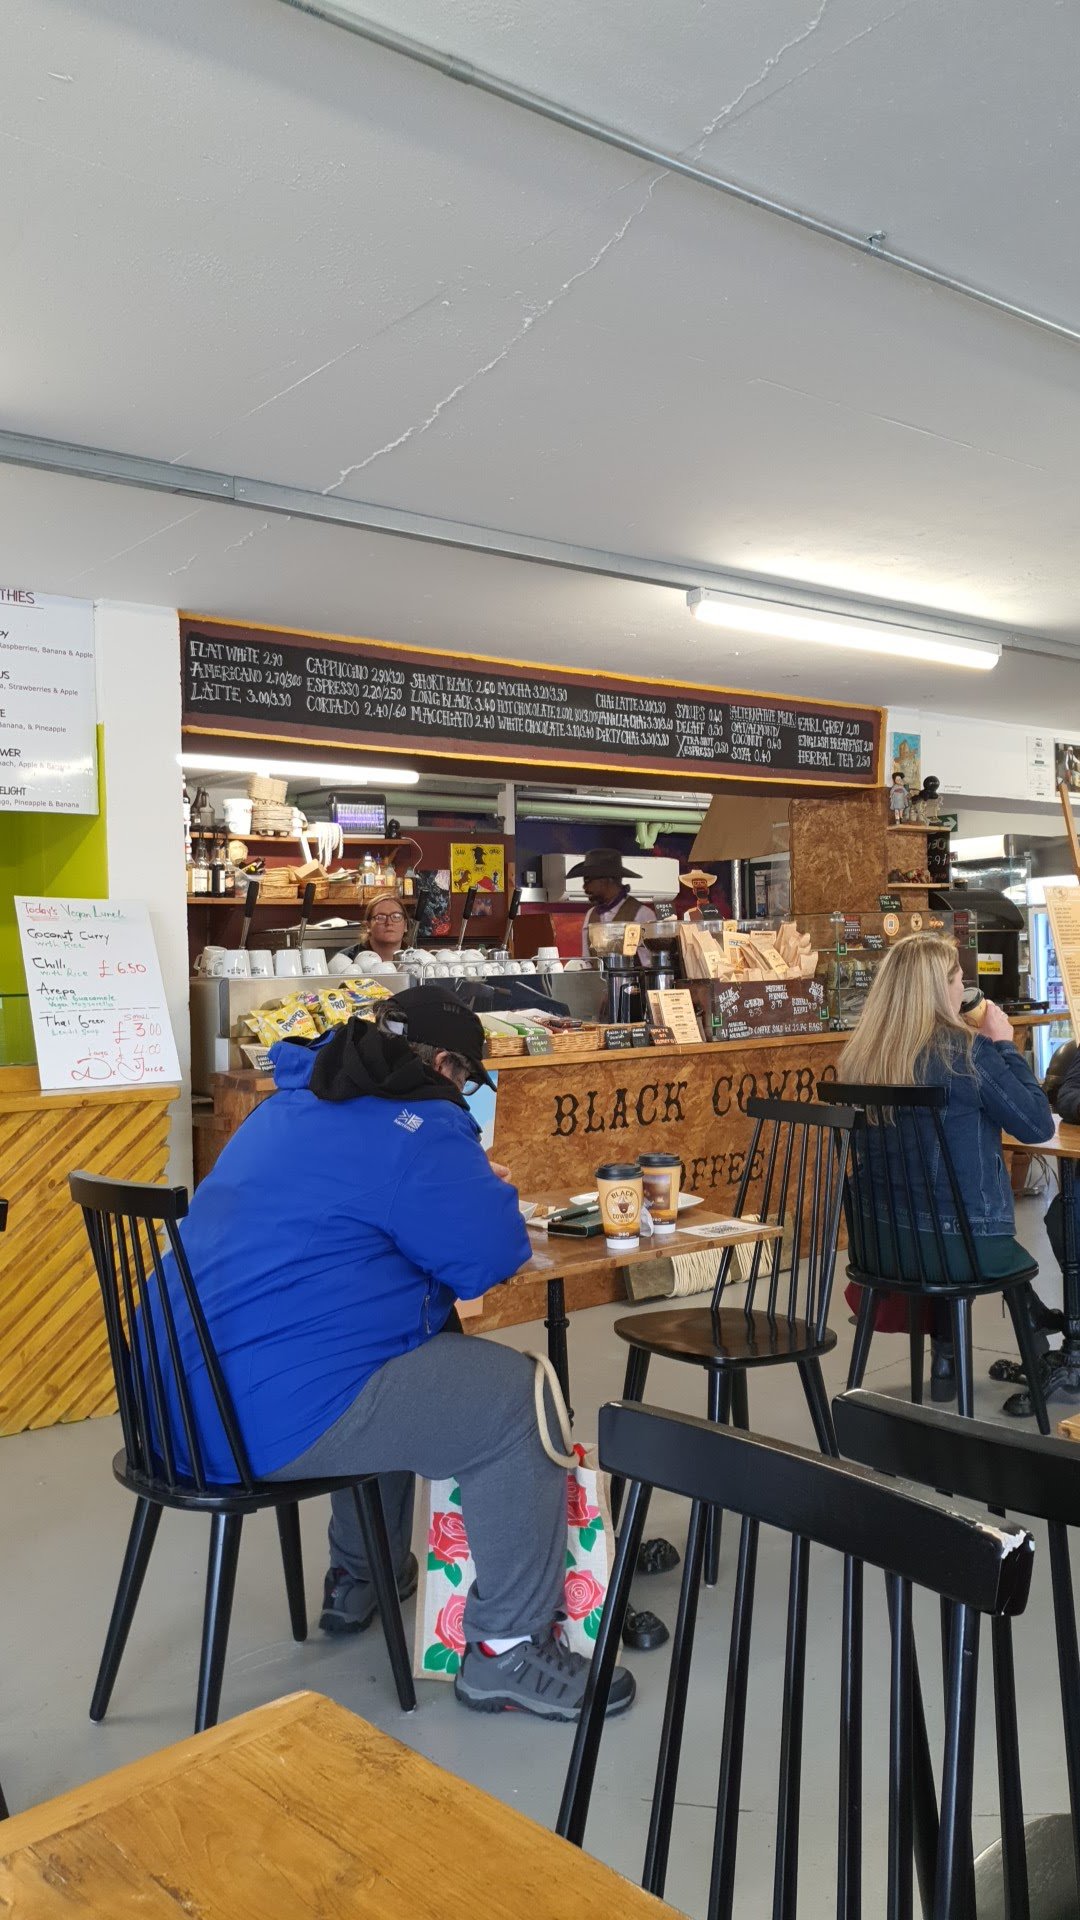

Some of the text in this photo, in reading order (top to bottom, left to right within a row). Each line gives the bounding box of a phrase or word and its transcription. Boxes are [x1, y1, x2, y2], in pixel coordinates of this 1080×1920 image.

[42, 647, 67, 655] Banana
[75, 651, 94, 659] Apple
[190, 641, 224, 660] FLAT
[263, 652, 283, 666] 2.90
[8, 683, 52, 694] Strawberries
[60, 689, 79, 697] Apple
[306, 678, 360, 697] ESPRESSO
[410, 673, 496, 694] SHORT BLACK 2.60
[498, 682, 532, 698] MOCHA
[190, 682, 242, 703] LATTE
[410, 690, 496, 712] LONG BLACK 3.40
[306, 696, 360, 716] CORTADO
[498, 700, 514, 714] HOT
[514, 701, 556, 718] CHOCOLATE
[615, 696, 640, 712] LATTE
[474, 714, 495, 730] 2.40
[675, 704, 723, 723] SYRUPS 0.40
[34, 723, 67, 734] Pineapple
[524, 719, 566, 736] CHOCOLATE
[676, 720, 723, 736] DECAFF 0.50
[798, 718, 822, 733] EARL
[822, 720, 845, 736] GREY
[714, 741, 729, 754] 0.50
[732, 733, 782, 750] COCONUT 0.40
[830, 736, 864, 752] BREAKFAST
[684, 745, 714, 758] ESPRESSO
[731, 746, 771, 763] SOYA 0.40
[798, 750, 836, 766] HERBAL
[837, 752, 854, 768] TEA
[18, 761, 38, 769] Apple
[14, 799, 47, 808] Pineapple
[22, 902, 128, 920] Today's Vegan Lunch
[26, 928, 110, 946] Coconut Curry
[32, 957, 147, 978] Chilli £ 6.50
[36, 982, 76, 996] Arepa
[40, 1014, 70, 1028] Thai
[78, 1014, 106, 1029] Green
[134, 1022, 162, 1037] 3.00
[281, 1008, 307, 1032] PROPER
[551, 1064, 839, 1137] BLACK COWBO
[611, 1190, 634, 1199] BLACK
